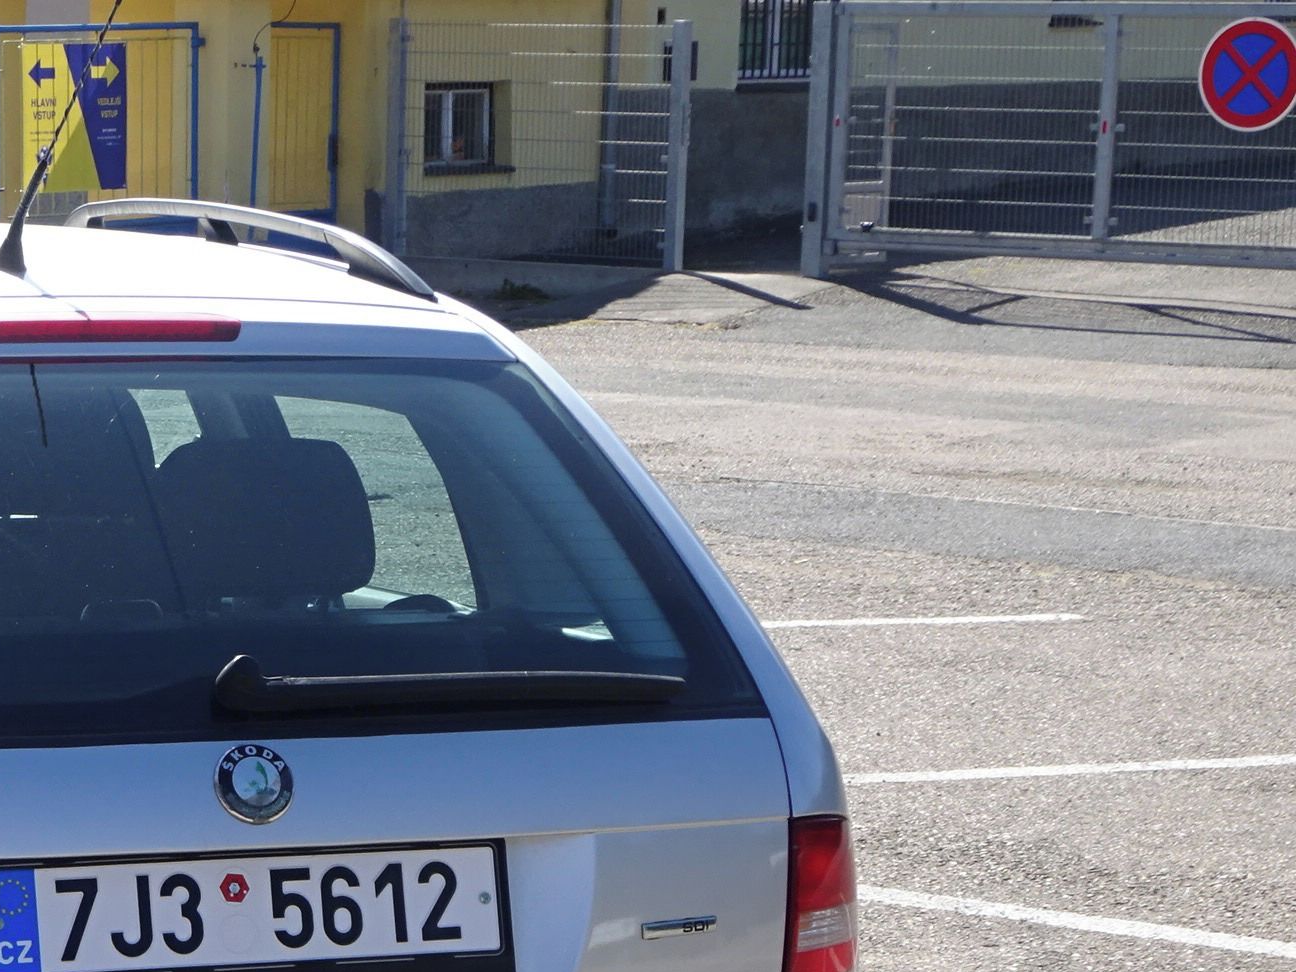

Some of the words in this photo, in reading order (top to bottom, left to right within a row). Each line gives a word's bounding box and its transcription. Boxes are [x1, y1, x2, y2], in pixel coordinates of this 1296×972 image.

[33, 111, 56, 120] VSTUP
[54, 873, 205, 963] 7J3
[268, 860, 463, 950] 5612
